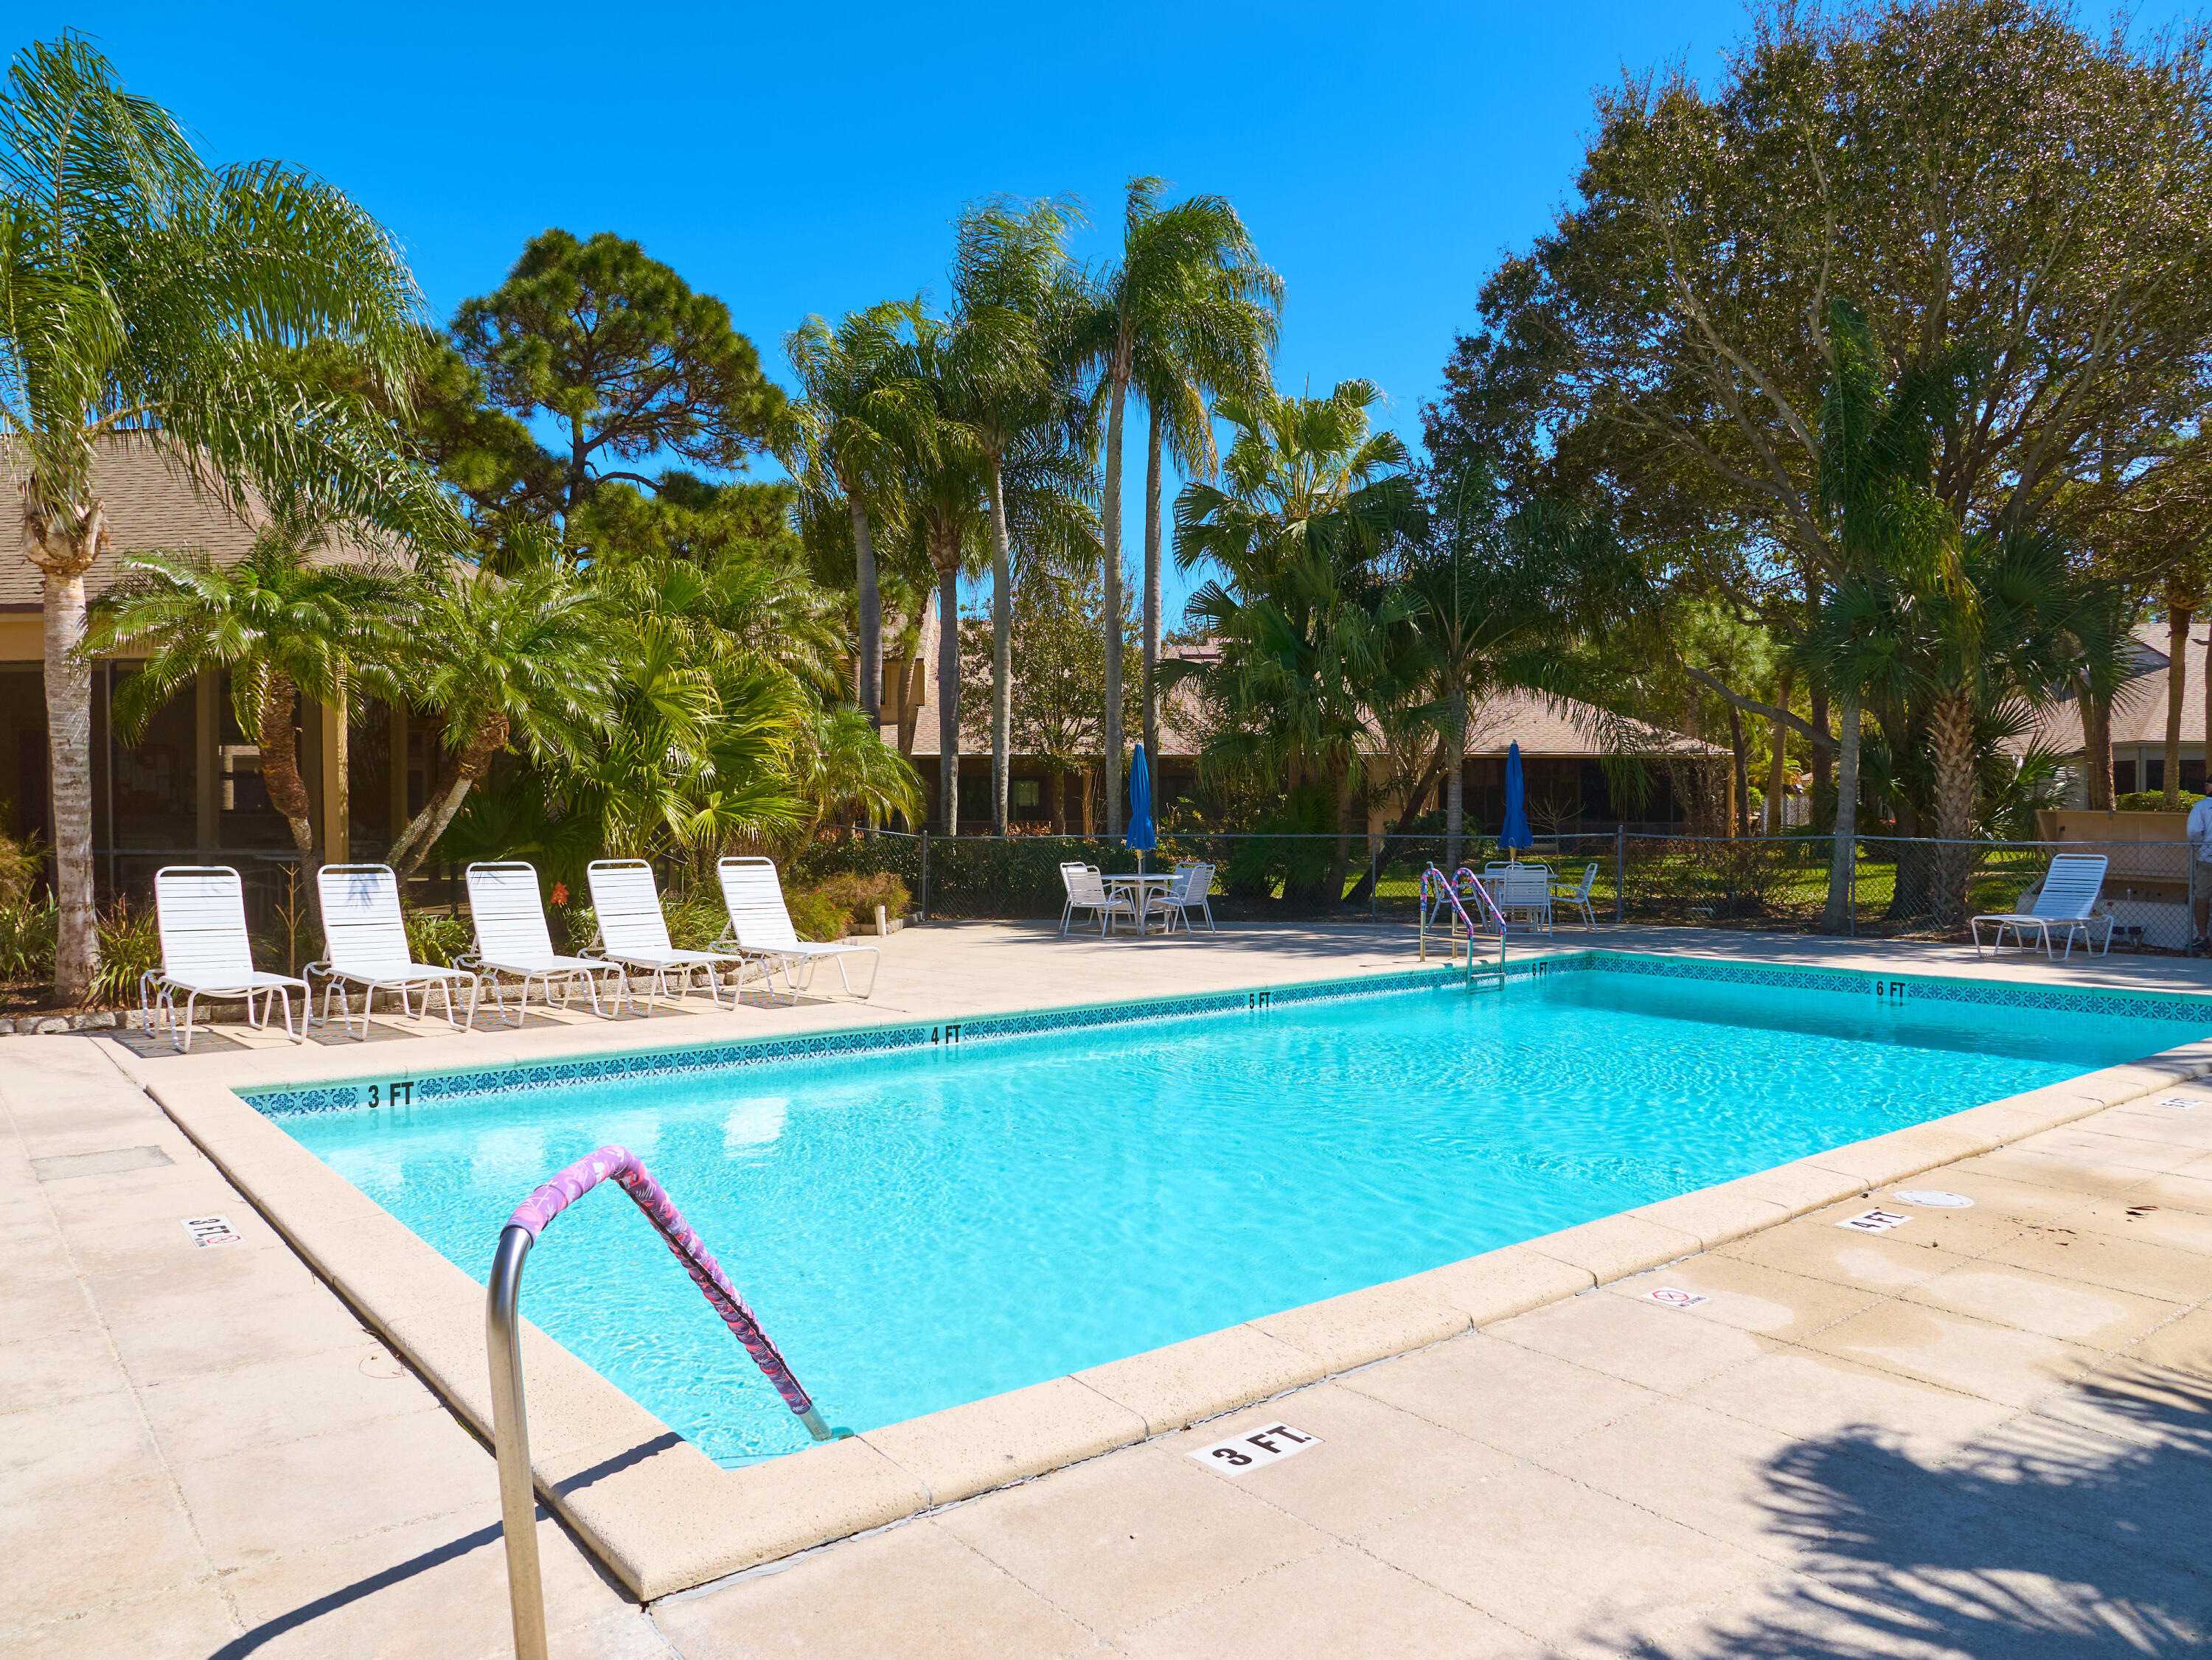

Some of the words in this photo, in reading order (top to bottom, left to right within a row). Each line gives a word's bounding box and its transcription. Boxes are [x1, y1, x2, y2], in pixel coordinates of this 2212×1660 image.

[1532, 963, 1537, 977] 6
[1540, 961, 1548, 976] FT
[1877, 980, 1884, 996] 6
[1890, 981, 1906, 997] FT
[1249, 993, 1255, 1010] 5
[1259, 991, 1271, 1008] FT
[931, 1026, 939, 1045] 4
[945, 1024, 961, 1045] FT
[368, 1084, 380, 1109] 3
[390, 1081, 414, 1107] FT
[1850, 1221, 1882, 1229] 4
[1211, 1448, 1253, 1466] 3
